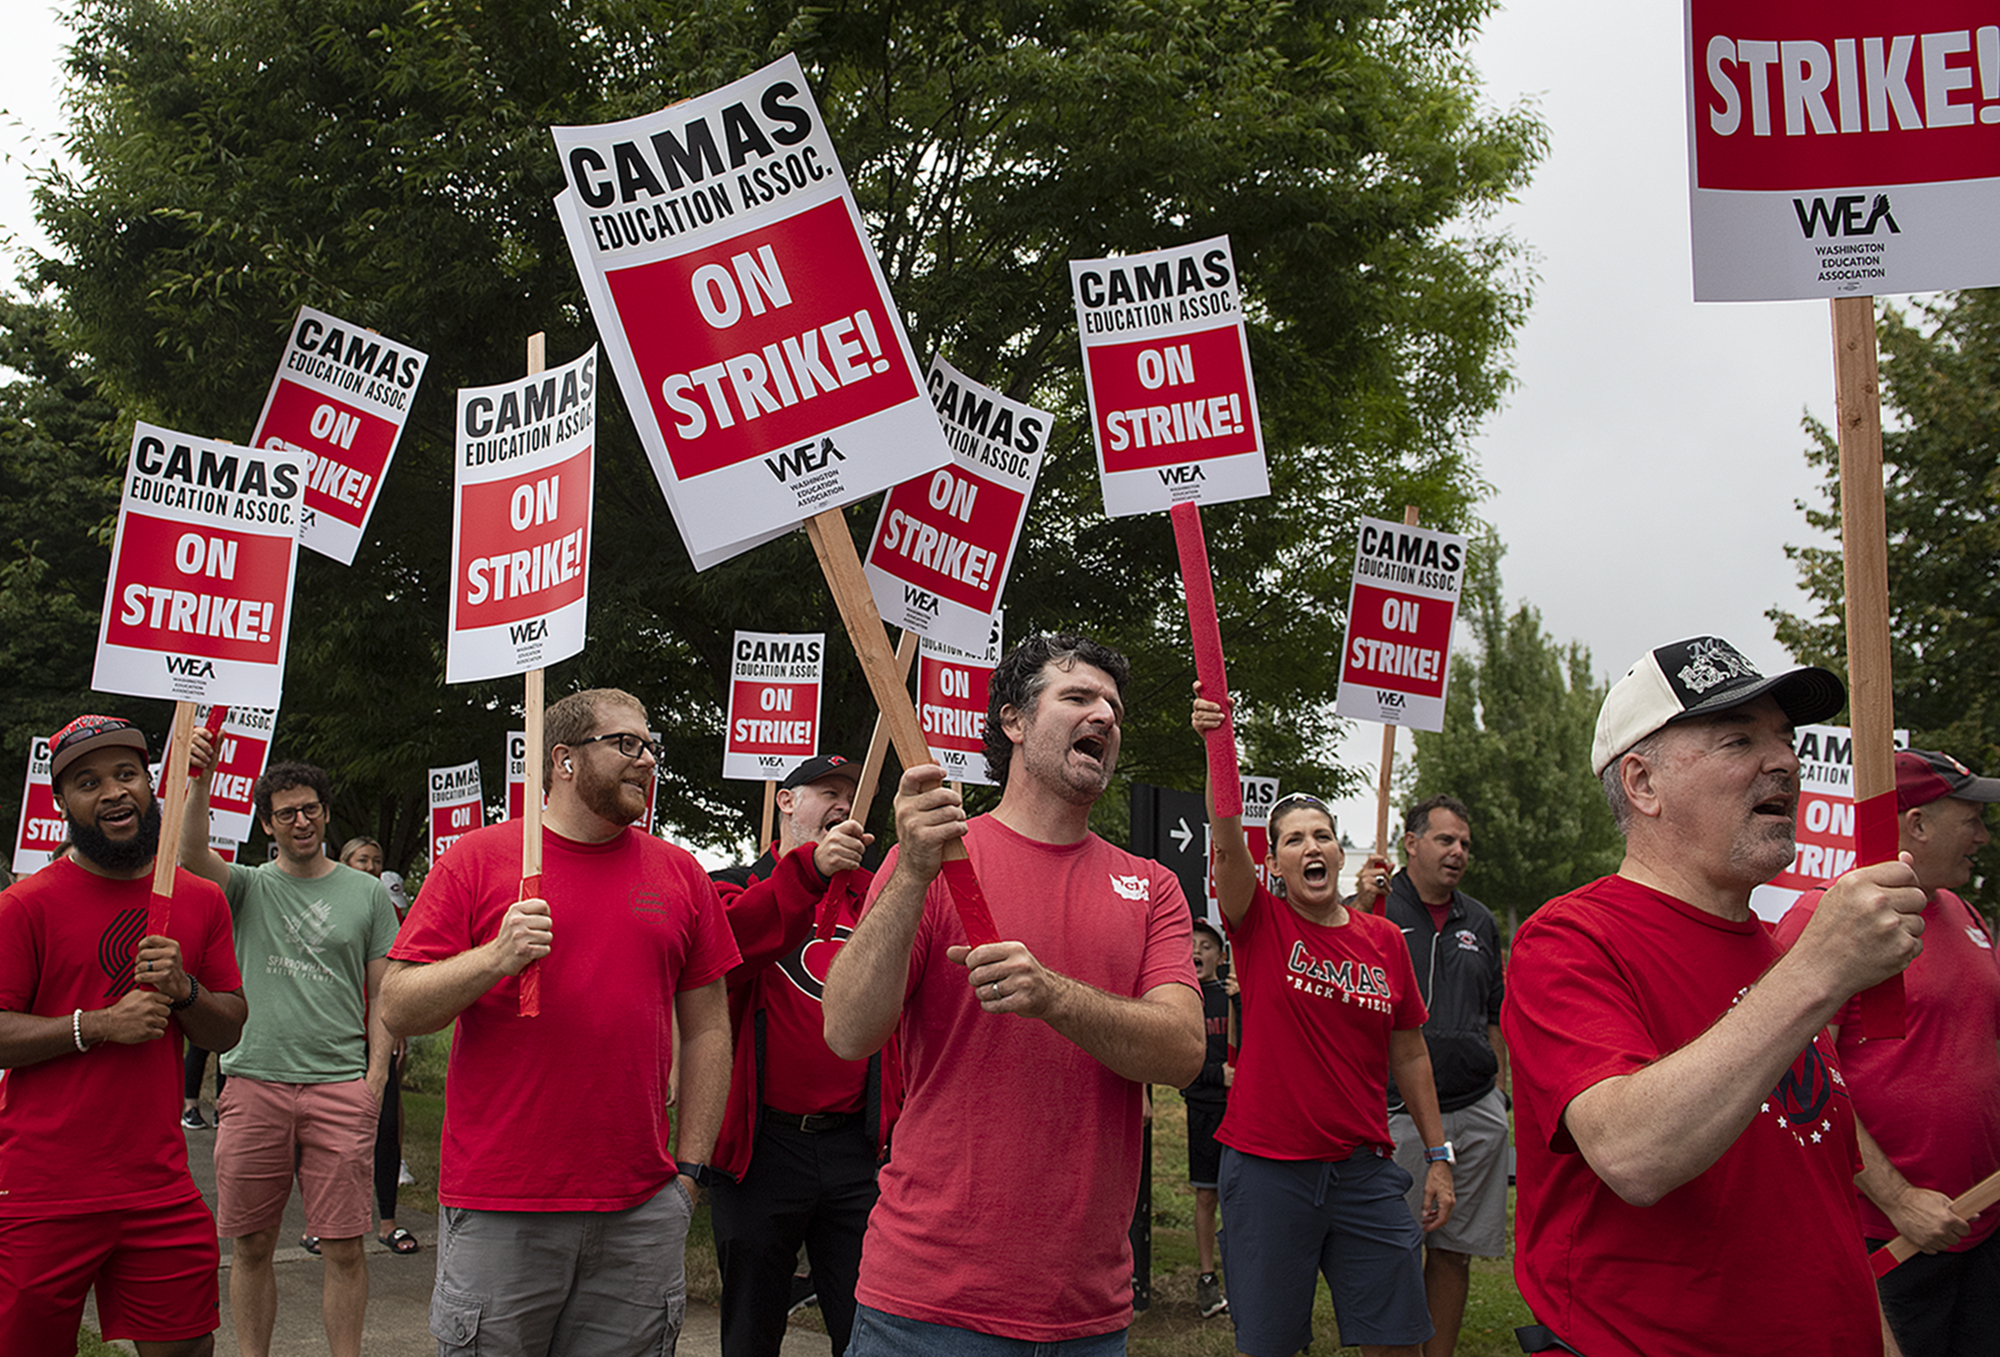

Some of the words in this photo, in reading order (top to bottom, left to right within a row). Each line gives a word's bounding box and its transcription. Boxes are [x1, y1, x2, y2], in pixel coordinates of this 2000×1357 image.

[1706, 25, 2000, 136] STRIKE!
[569, 81, 812, 209] CAMAS
[589, 182, 734, 251] EDUCATION
[738, 146, 833, 210] ASSOC.
[1793, 194, 1901, 238] WEA
[1815, 243, 1885, 256] WASHINGTON
[1822, 256, 1880, 268] EDUCATION
[691, 244, 792, 330] ON
[1079, 249, 1231, 308] CAMAS
[1818, 268, 1885, 281] ASSOCIATION
[1085, 302, 1174, 334] EDUCATION
[1180, 290, 1237, 321] ASSOC.
[295, 318, 419, 389] CAMAS
[1137, 344, 1195, 389] ON
[287, 350, 362, 394] EDUCATION
[364, 378, 407, 412] ASSOC.
[662, 309, 891, 440] STRIKE!
[465, 356, 594, 438] CAMAS
[928, 368, 1043, 454] CAMAS
[310, 404, 361, 450] ON
[465, 423, 551, 467] EDUCATION
[556, 402, 593, 444] ASSOC.
[1106, 393, 1245, 451] STRIKE!
[135, 436, 300, 499] CAMAS
[264, 437, 372, 508] RIKE!
[764, 437, 846, 482] WEA
[980, 444, 1030, 480] ASSOC.
[1157, 464, 1206, 485] WEA
[790, 469, 839, 491] WASHINGTON
[797, 478, 838, 498] EDUCATION
[798, 485, 845, 507] ASSOCIATION
[928, 470, 978, 523] ON
[130, 477, 228, 516] EDUCATION
[233, 498, 294, 525] ASSOC.
[510, 475, 559, 531] ON
[175, 533, 238, 580] ON
[467, 528, 583, 605] STRIKE!
[883, 508, 998, 592] STRIKE!
[1361, 526, 1462, 572] CAMAS
[1358, 557, 1416, 584] EDUCATION
[1418, 569, 1458, 593] ASSOC.
[120, 583, 274, 643] STRIKE!
[905, 585, 939, 616] WEA
[1382, 598, 1420, 634] ON
[510, 619, 548, 645] WEA
[165, 655, 216, 679] WEA
[735, 663, 787, 677] EDUCATION
[789, 665, 819, 678] ASSOC.
[736, 640, 821, 664] CAMAS
[1351, 636, 1441, 682] STRIKE!
[760, 687, 792, 711] ON
[940, 667, 969, 699] ON
[1376, 690, 1406, 708] WEA
[237, 711, 272, 731] ASSOC.
[735, 718, 812, 745] STRIKE!
[922, 703, 988, 739] STRIKE
[218, 739, 238, 764] N
[758, 756, 784, 767] WEA
[943, 752, 967, 766] WEA
[210, 771, 253, 802] IKE!
[431, 765, 480, 791] CAMAS
[1798, 762, 1849, 786] CATION
[26, 818, 69, 842] STRI
[451, 807, 470, 828] ON
[1805, 800, 1855, 837] ON
[1288, 940, 1391, 998] CAMAS
